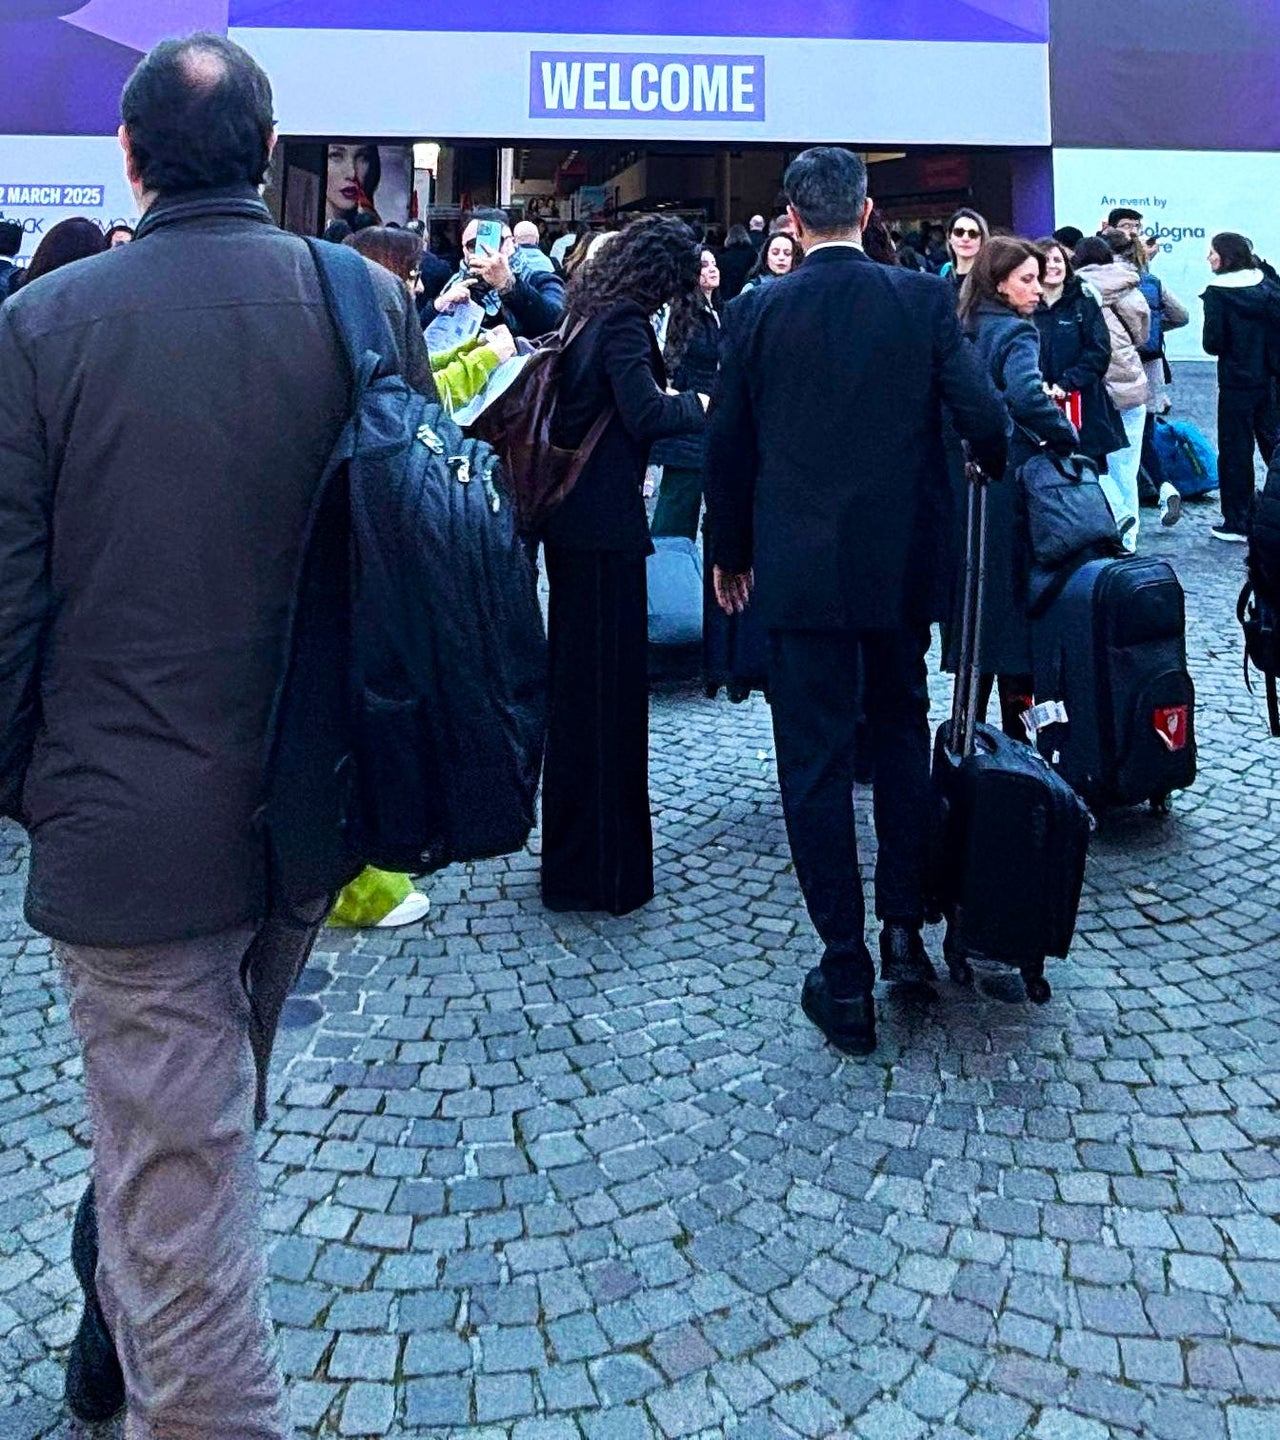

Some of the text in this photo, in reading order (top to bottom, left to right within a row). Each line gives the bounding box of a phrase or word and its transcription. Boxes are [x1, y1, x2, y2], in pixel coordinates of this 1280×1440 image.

[541, 61, 755, 113] WELCOME
[7, 187, 61, 204] MARCH
[63, 187, 101, 204] 2025
[1101, 195, 1167, 209] An event by
[1139, 221, 1206, 242] ologna
